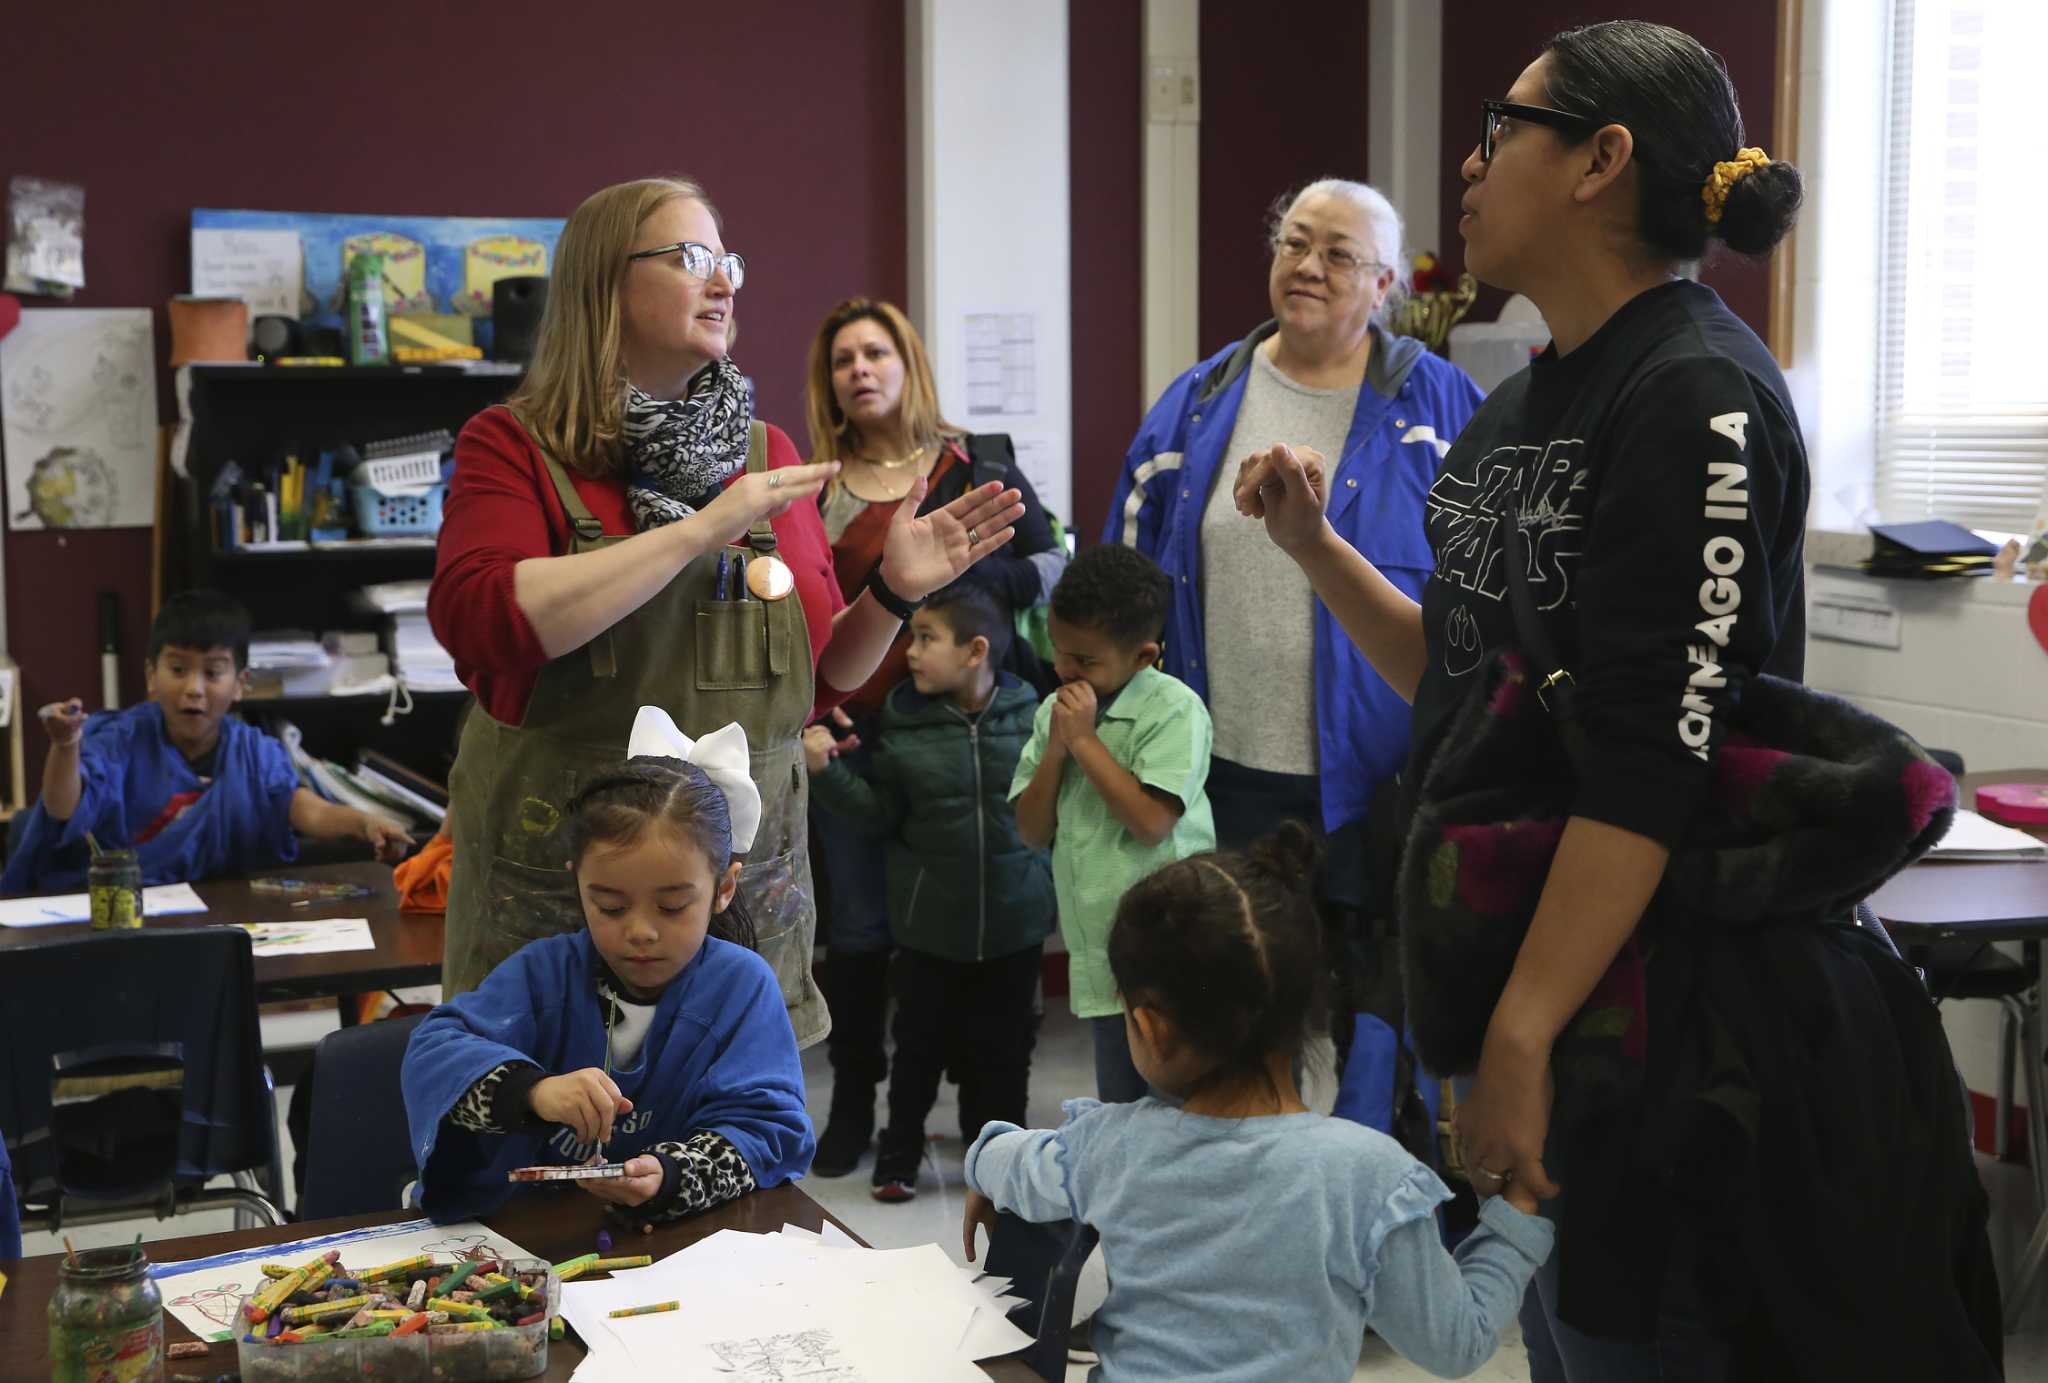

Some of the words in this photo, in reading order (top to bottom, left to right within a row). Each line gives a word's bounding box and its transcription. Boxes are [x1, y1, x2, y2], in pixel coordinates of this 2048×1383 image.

[1709, 411, 1749, 451] A
[1704, 462, 1749, 520] IN
[1694, 536, 1746, 647] AGO
